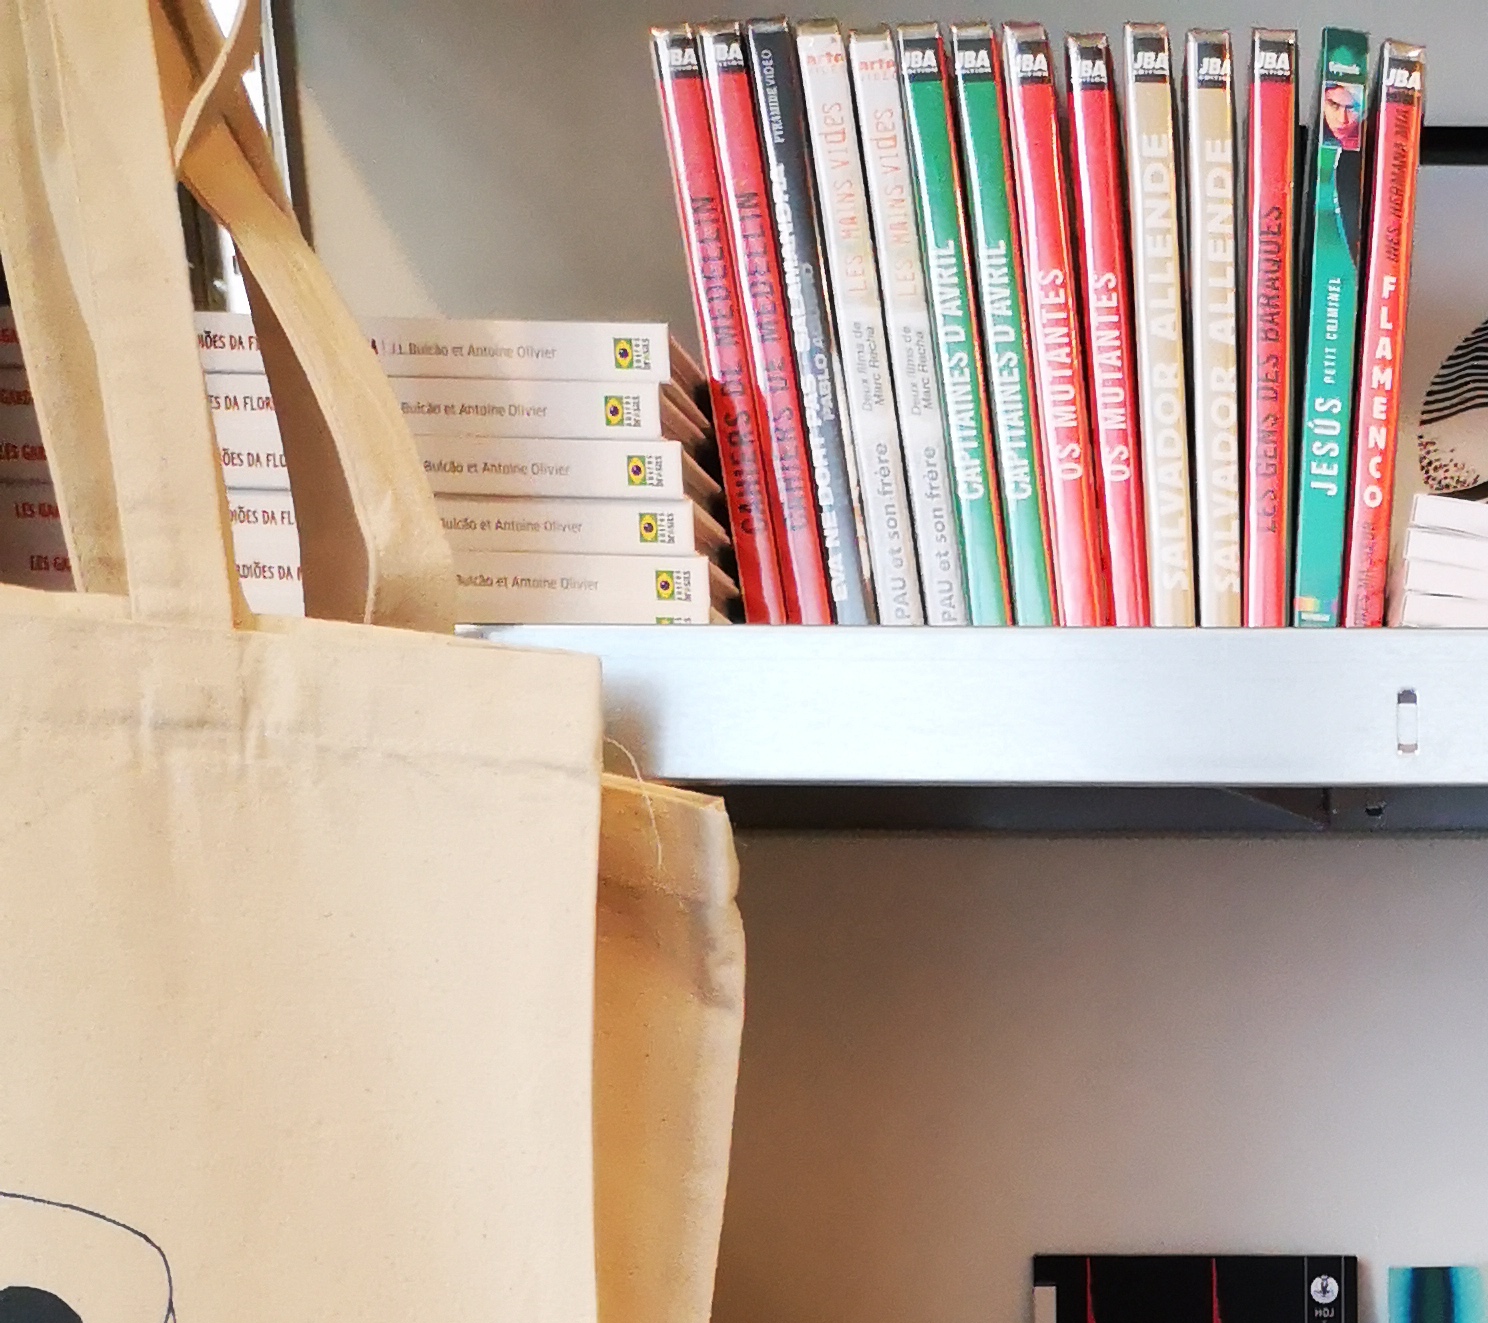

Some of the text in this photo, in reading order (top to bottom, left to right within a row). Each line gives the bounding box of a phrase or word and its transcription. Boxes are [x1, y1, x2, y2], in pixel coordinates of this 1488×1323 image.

[806, 51, 844, 67] arte
[1134, 51, 1168, 70] JBA
[1198, 56, 1231, 75] JBA
[1254, 51, 1290, 70] JBA
[1384, 67, 1422, 90] JBA
[834, 177, 868, 295] LES MAINS
[885, 183, 917, 298] LES MAINS
[1257, 204, 1285, 342] BARAQUES
[451, 343, 558, 360] et Antoine Olivier
[801, 372, 825, 423] PAS
[813, 353, 836, 422] PABLO
[932, 239, 985, 500] CAPITAINES D'AVRIL
[982, 239, 1032, 500] CAPITAINES D'AVRIL
[1037, 268, 1083, 482] OS MUTANTES
[1090, 272, 1132, 483] OS MUTANTES
[1141, 133, 1189, 592] SALVADOR ALLENDE
[1204, 138, 1242, 595] SALVADOR ALLENDE
[1362, 275, 1398, 509] FLAMENCO
[225, 395, 240, 411] DA
[443, 403, 548, 418] et Antoine Olivier
[1309, 396, 1343, 497] JESÚS
[810, 424, 836, 507] DORT
[822, 511, 841, 547] NE
[827, 548, 850, 601] EVA
[874, 442, 911, 620] PAU et son frère
[924, 446, 958, 622] PAU et son frère
